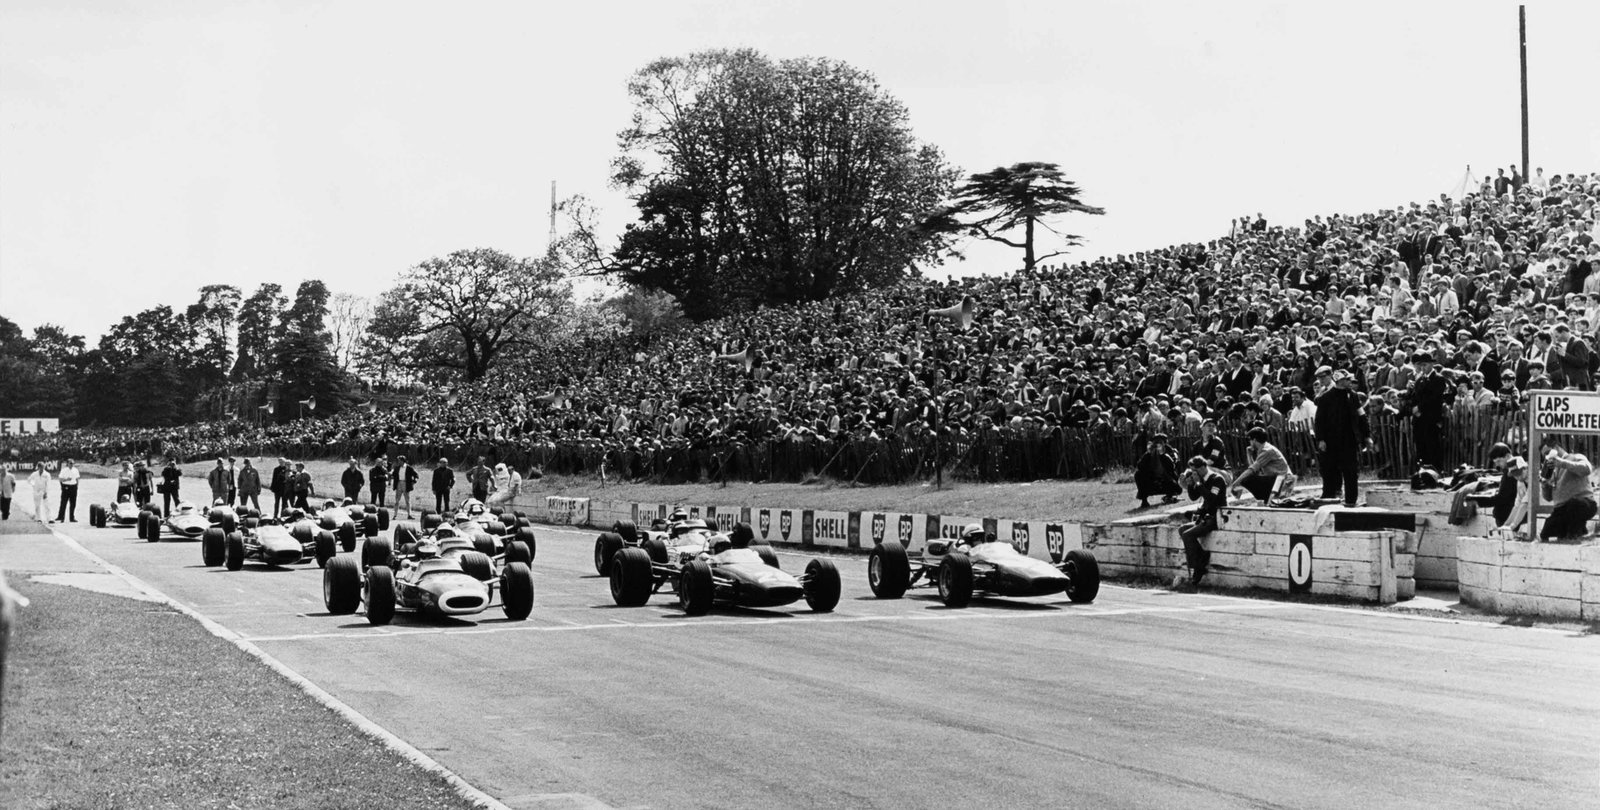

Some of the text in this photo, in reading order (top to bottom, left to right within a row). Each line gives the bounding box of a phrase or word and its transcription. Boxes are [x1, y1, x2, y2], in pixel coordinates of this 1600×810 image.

[1538, 396, 1569, 412] LAPS
[1537, 412, 1600, 429] COMPLETE
[815, 518, 847, 540] SHELL
[873, 519, 912, 540] BP BP
[1014, 529, 1063, 554] BP BP
